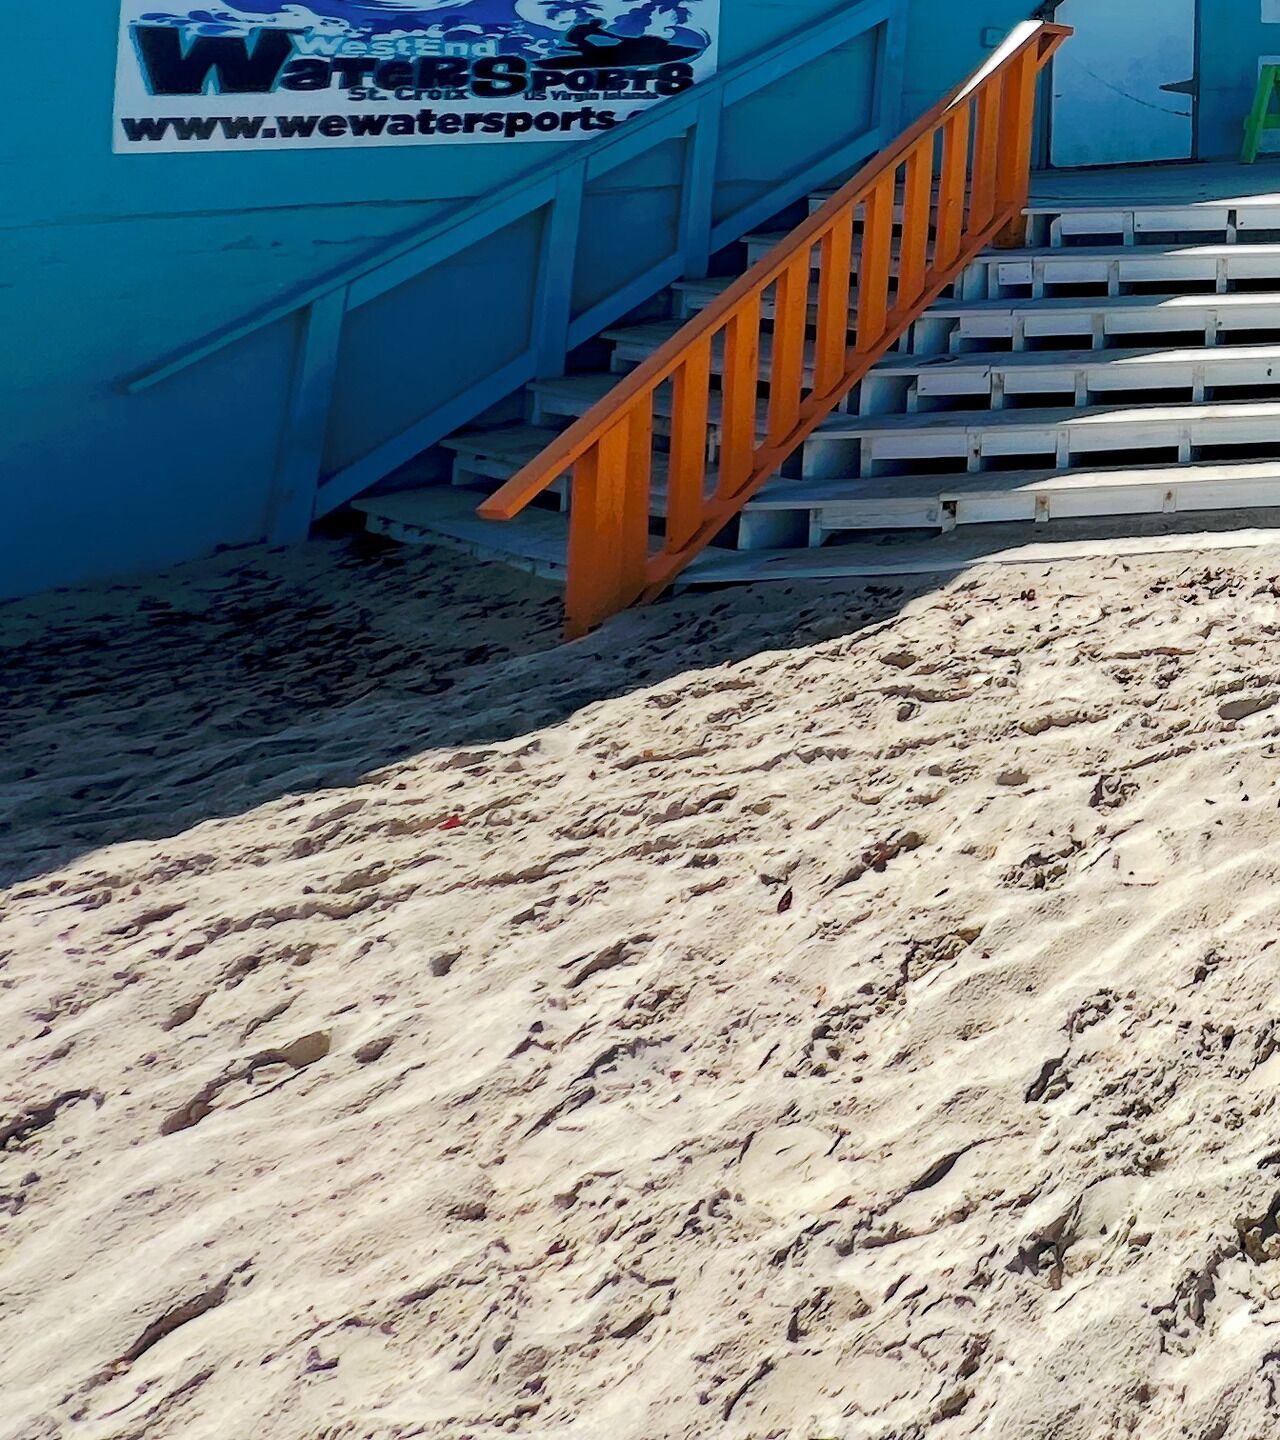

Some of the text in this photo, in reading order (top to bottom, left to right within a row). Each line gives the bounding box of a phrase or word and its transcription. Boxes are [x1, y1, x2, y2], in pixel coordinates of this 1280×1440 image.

[347, 86, 468, 101] St. Croix
[550, 90, 600, 103] Virgin
